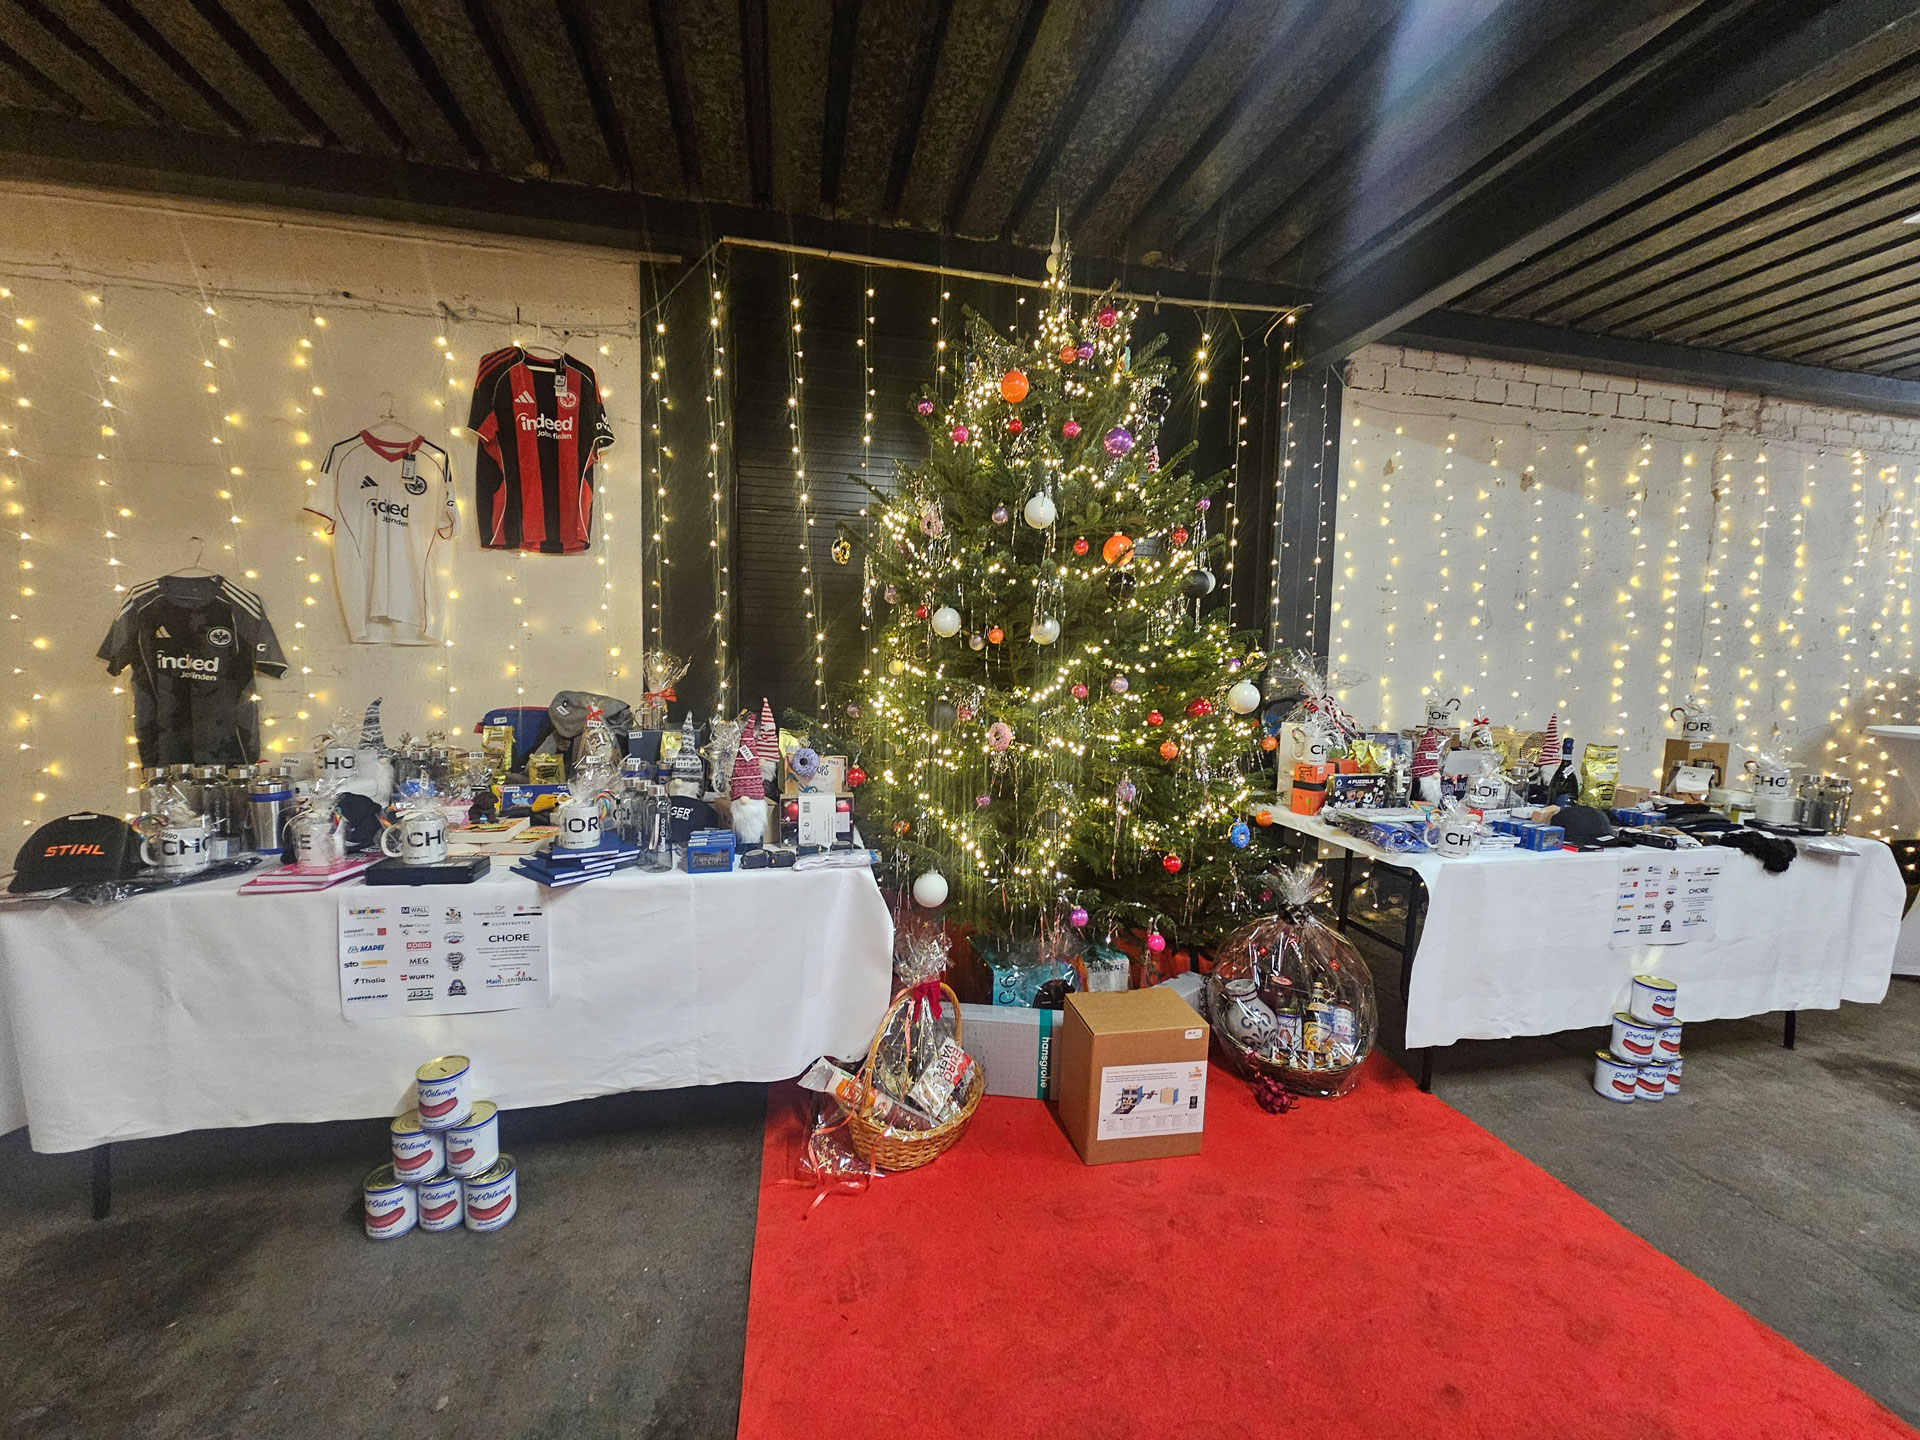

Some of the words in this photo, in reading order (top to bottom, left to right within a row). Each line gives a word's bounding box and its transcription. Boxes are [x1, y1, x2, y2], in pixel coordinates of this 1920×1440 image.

[517, 413, 573, 431] indeed
[44, 844, 104, 857] STIHL
[488, 933, 530, 943] CHORE
[360, 944, 385, 952] MAPEI
[409, 957, 429, 965] MEG
[943, 1047, 961, 1082] EURO
[1040, 1037, 1053, 1088] hansgrohe
